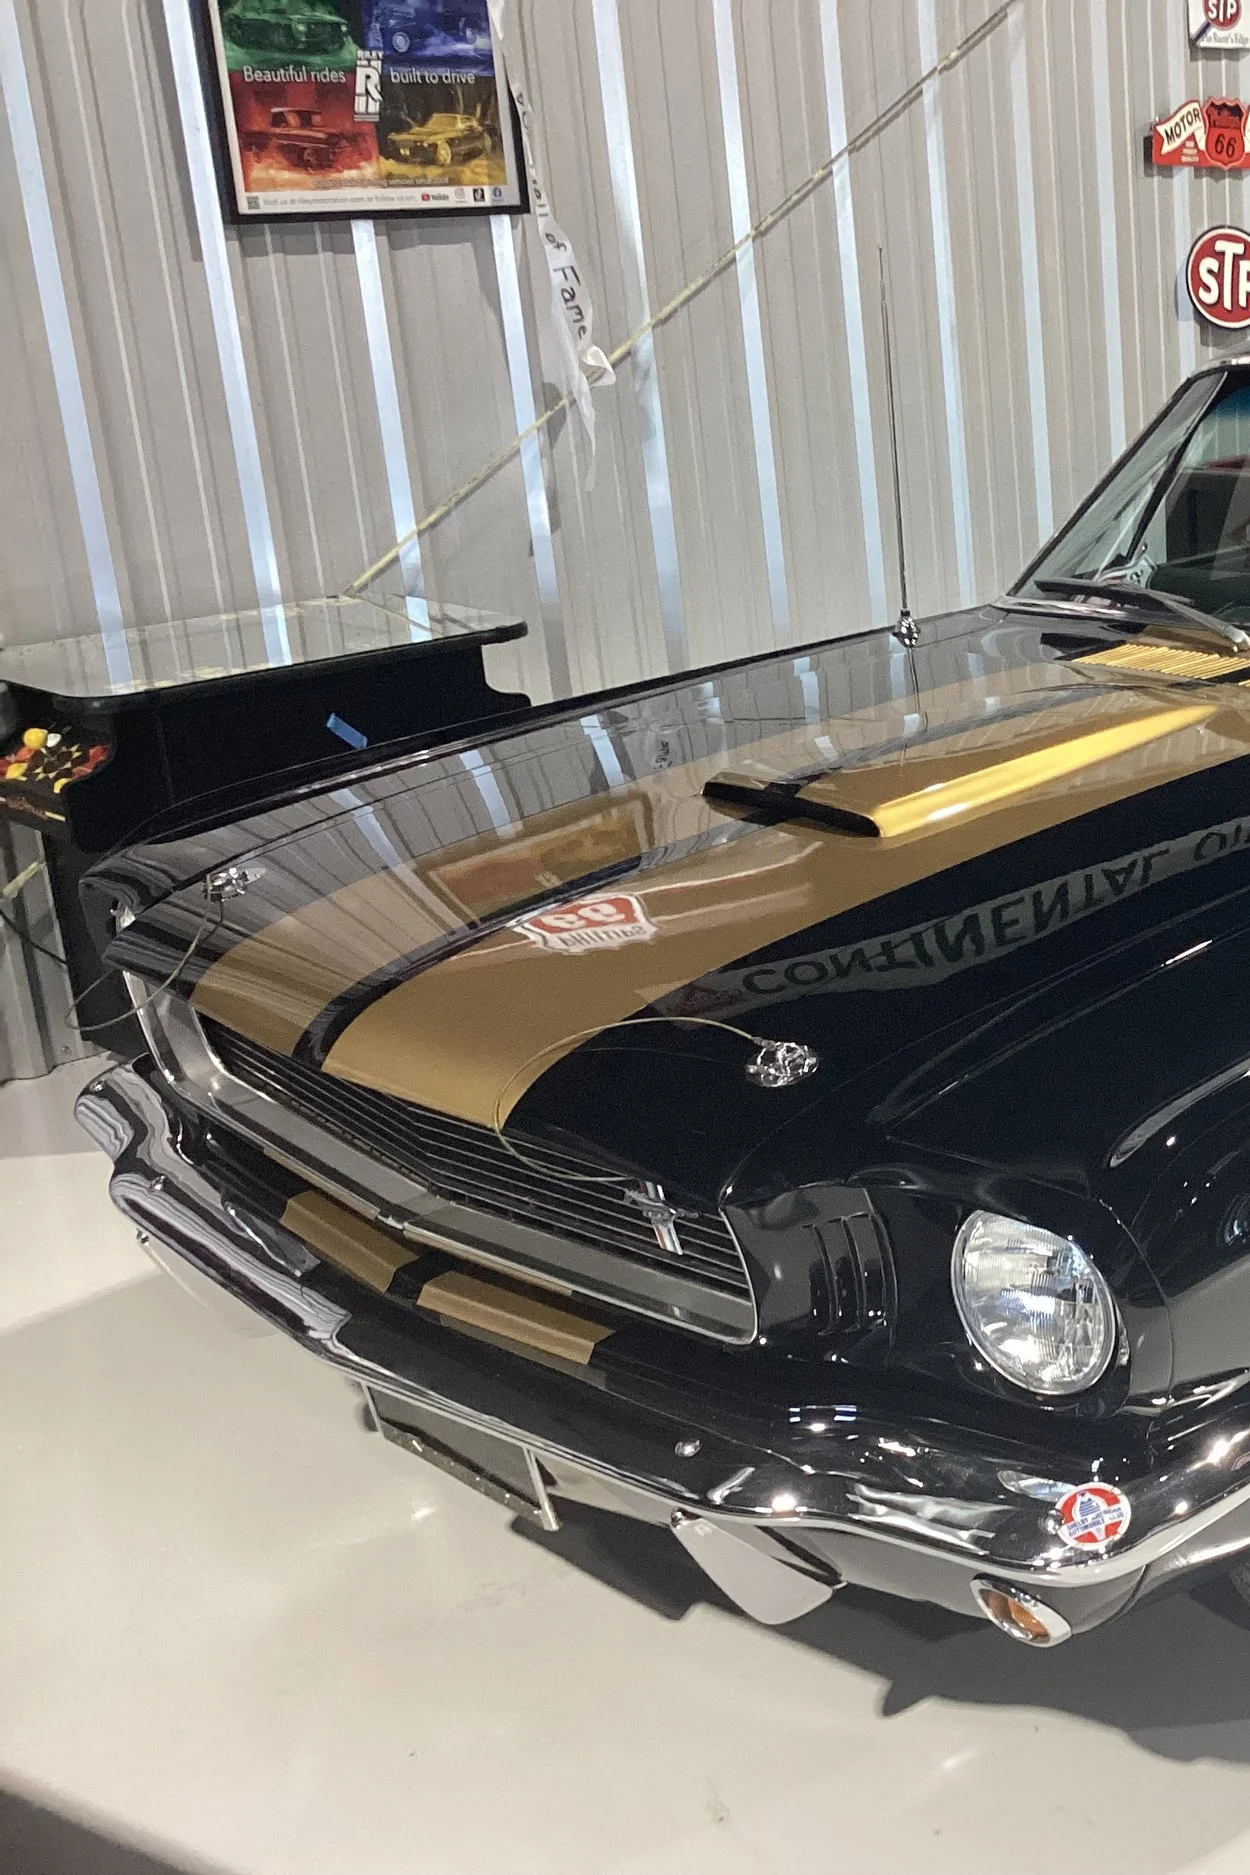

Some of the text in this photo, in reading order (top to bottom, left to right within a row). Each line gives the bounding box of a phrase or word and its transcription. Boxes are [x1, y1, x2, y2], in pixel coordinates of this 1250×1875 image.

[243, 65, 346, 83] Beautiful rides
[390, 66, 476, 84] built to drive
[1163, 107, 1202, 146] MOTOR
[1214, 133, 1237, 158] 66
[545, 232, 567, 252] of
[553, 265, 588, 340] Fame
